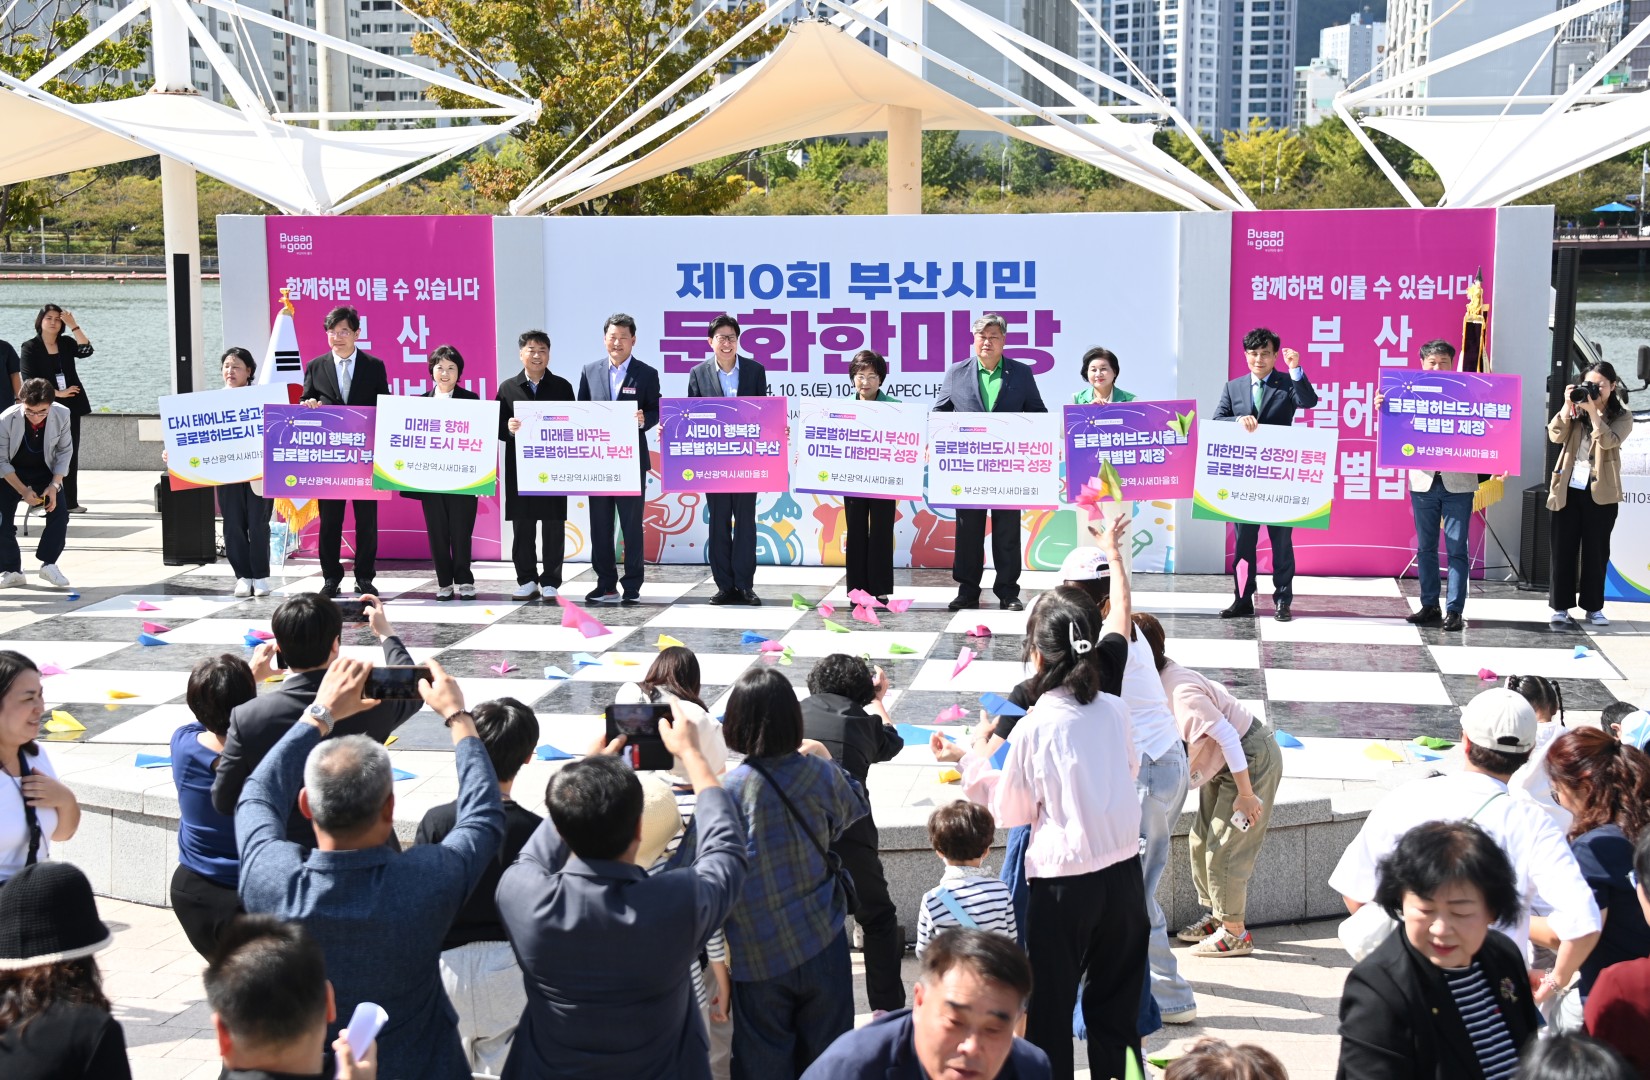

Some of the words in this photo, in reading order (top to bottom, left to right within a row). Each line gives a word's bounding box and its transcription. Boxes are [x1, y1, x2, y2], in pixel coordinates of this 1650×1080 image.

[280, 232, 312, 242] Busan
[1247, 228, 1284, 238] Busan
[287, 241, 312, 253] good
[1255, 238, 1284, 250] good
[676, 261, 830, 300] 제10회
[848, 260, 1037, 300] 부산시민
[1251, 275, 1324, 300] 함께하면
[1330, 275, 1368, 300] 이룰
[1373, 275, 1392, 300] 수
[1398, 275, 1474, 300] 있습니다
[286, 277, 350, 300] 함께하면
[356, 278, 388, 301] 이룰
[393, 278, 410, 301] 수
[414, 277, 480, 301] 있습니다
[659, 307, 1061, 375] 문화한마당
[779, 383, 798, 397] 10.
[886, 384, 922, 397] APEC
[1388, 398, 1512, 419] 글로벌허브도시출발
[168, 415, 190, 430] 다시
[192, 410, 237, 427] 태어나도
[238, 406, 264, 421] 살고
[405, 418, 440, 432] 미래를
[444, 420, 470, 434] 향해
[686, 424, 721, 438] 시민이
[724, 424, 760, 438] 행복한
[1414, 417, 1454, 434] 특별법
[1458, 420, 1485, 436] 제정
[176, 425, 254, 446] 글로벌허브도시
[290, 431, 326, 446] 시민이
[328, 432, 366, 447] 행복한
[540, 428, 574, 442] 미래를
[576, 428, 610, 442] 바꾸는
[805, 426, 882, 444] 글로벌허브도시
[886, 430, 920, 446] 부산이
[390, 434, 426, 449] 준비된
[430, 436, 454, 450] 도시
[458, 438, 483, 452] 부산
[669, 441, 752, 456] 글로벌허브도시
[755, 440, 780, 456] 부산
[935, 440, 1014, 454] 글로벌허브도시
[1018, 442, 1052, 456] 부산이
[202, 450, 264, 465] 부산광역시새마
[272, 447, 358, 464] 글로벌허브도시
[360, 449, 374, 464] 부
[523, 446, 604, 460] 글로벌허브도시,
[606, 446, 632, 459] 부산!
[808, 444, 842, 458] 이끄는
[845, 446, 891, 462] 대한민국
[894, 449, 918, 464] 성장
[1098, 449, 1136, 464] 특별법
[1140, 448, 1165, 463] 제정
[1206, 443, 1257, 460] 대한민국
[1260, 448, 1298, 463] 성장의
[1300, 450, 1326, 466] 동력
[1416, 446, 1498, 459] 부산광역시새마을회
[406, 462, 476, 473] 부산광역시새마을회
[939, 458, 974, 472] 이끄는
[976, 458, 1024, 472] 대한민국
[1027, 459, 1052, 473] 성장
[1206, 461, 1294, 481] 글로벌허브도시
[1298, 468, 1324, 483] 부산
[298, 476, 372, 486] 부산광역시새마을회
[550, 473, 621, 482] 부산광역시새마을회
[696, 470, 768, 479] 부산광역시새마을회
[831, 472, 904, 485] 부산광역시새마을회
[1120, 476, 1179, 487] 광역시새마을회
[964, 486, 1038, 496] 부산광역시새마을회
[1231, 491, 1310, 505] 부산광역시새마을회
